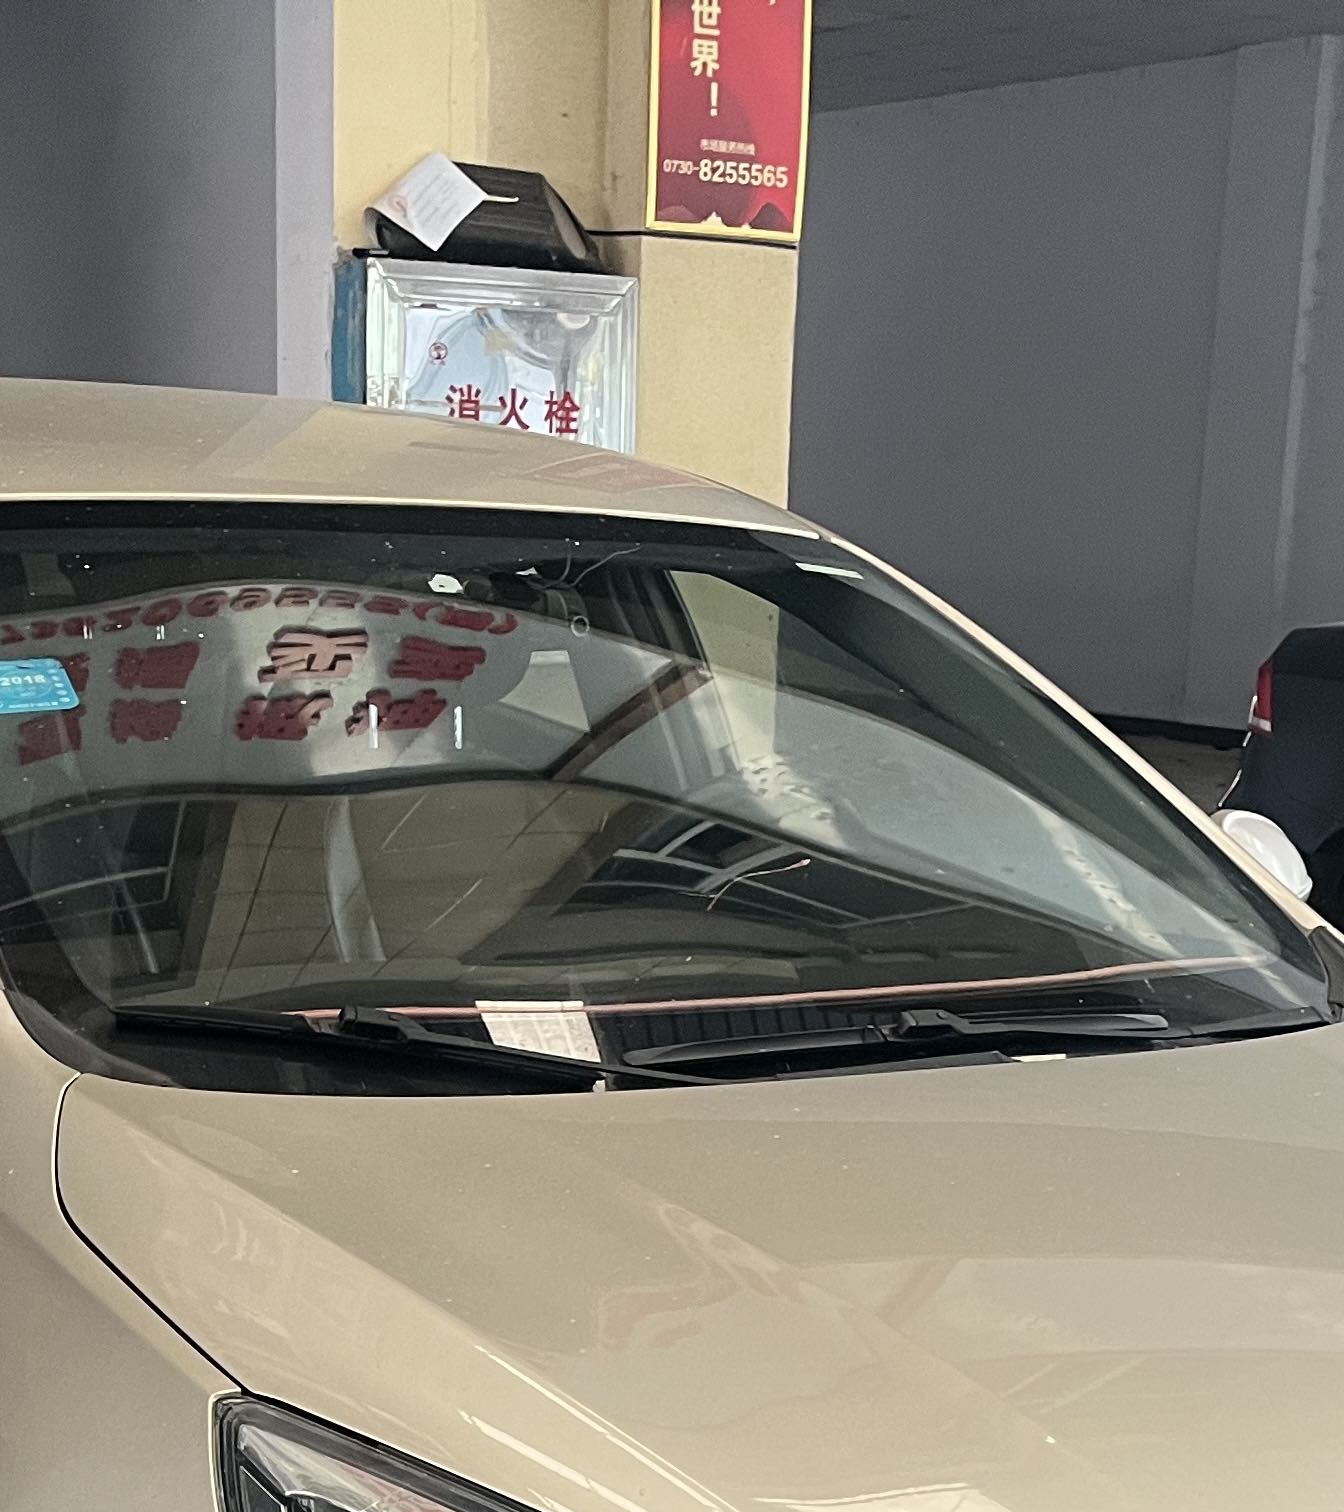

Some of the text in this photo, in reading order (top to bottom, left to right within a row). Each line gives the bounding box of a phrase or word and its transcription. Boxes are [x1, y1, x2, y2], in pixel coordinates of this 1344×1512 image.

[662, 158, 790, 188] 0730-8255565
[444, 383, 582, 434] 消火栓
